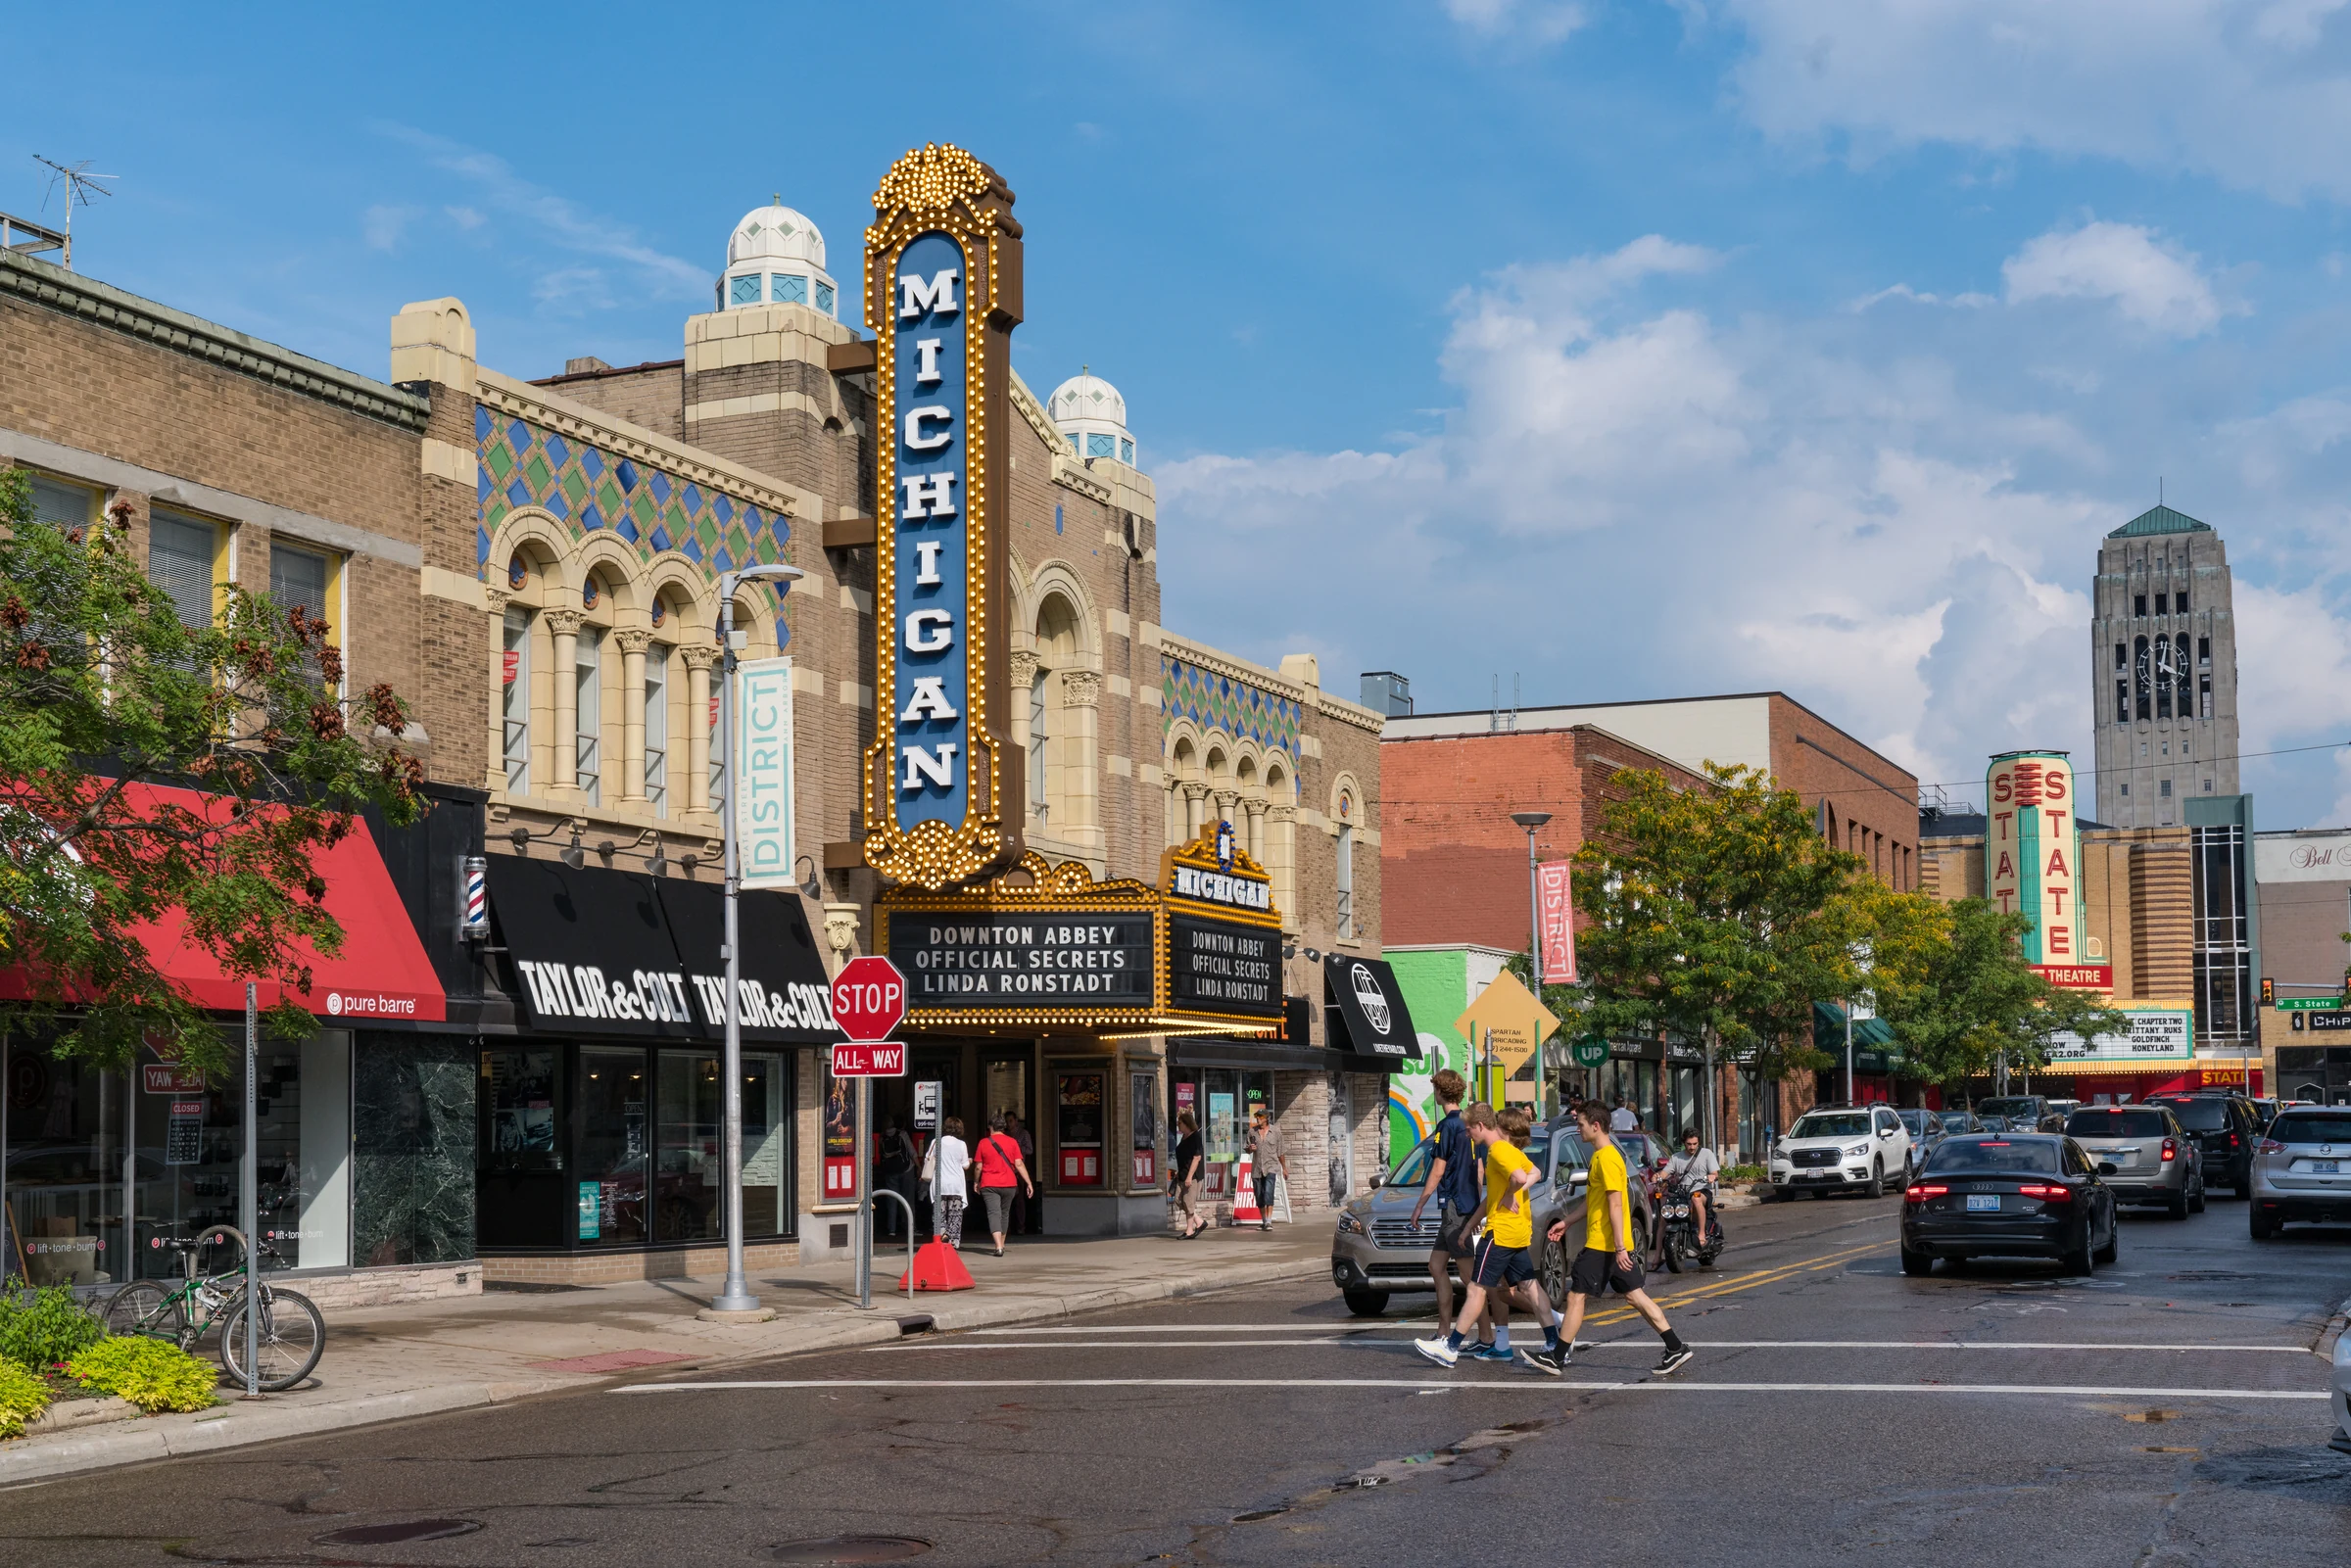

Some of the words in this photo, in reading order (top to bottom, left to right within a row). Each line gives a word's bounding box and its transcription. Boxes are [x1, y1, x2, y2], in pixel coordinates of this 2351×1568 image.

[898, 267, 960, 789] MICHIGAN
[751, 681, 780, 866] DISTRICT
[741, 830, 749, 866] STATE
[2289, 843, 2332, 870] Bell
[2044, 770, 2068, 955] STATE
[1176, 865, 1270, 910] MICHIGAN
[1546, 873, 1566, 973] DISTRICT
[930, 927, 1032, 945] DOWNTON
[1044, 927, 1116, 944] ABBEY
[1192, 930, 1234, 954] DOWNTON
[1237, 935, 1265, 958] ABBEY
[915, 950, 1018, 969] OFFICIAL
[1029, 950, 1126, 969] SECRETS
[1192, 953, 1232, 976] OFFICIAL
[1234, 959, 1270, 980] SECRETS
[924, 974, 989, 992] LINDA
[1000, 974, 1114, 992] RONSTADT
[2047, 969, 2101, 983] THEATRE
[518, 960, 692, 1023] TAYLOR&COLT
[836, 982, 900, 1015] STOP
[1195, 977, 1223, 998] LINDA
[1225, 981, 1269, 1002] RONSTADT
[344, 996, 376, 1015] pure
[378, 994, 415, 1014] barre
[836, 1050, 862, 1070] ALL
[872, 1049, 901, 1069] WAY
[1580, 1047, 1604, 1061] UP
[1248, 1089, 1262, 1099] OPEN
[172, 1104, 200, 1113] CLOSED
[625, 1104, 644, 1113] OPEN
[275, 1230, 285, 1240] lift
[288, 1231, 303, 1240] tone
[307, 1229, 323, 1238] burn
[37, 1242, 48, 1254] lift
[53, 1243, 72, 1254] tone
[76, 1241, 96, 1252] burn
